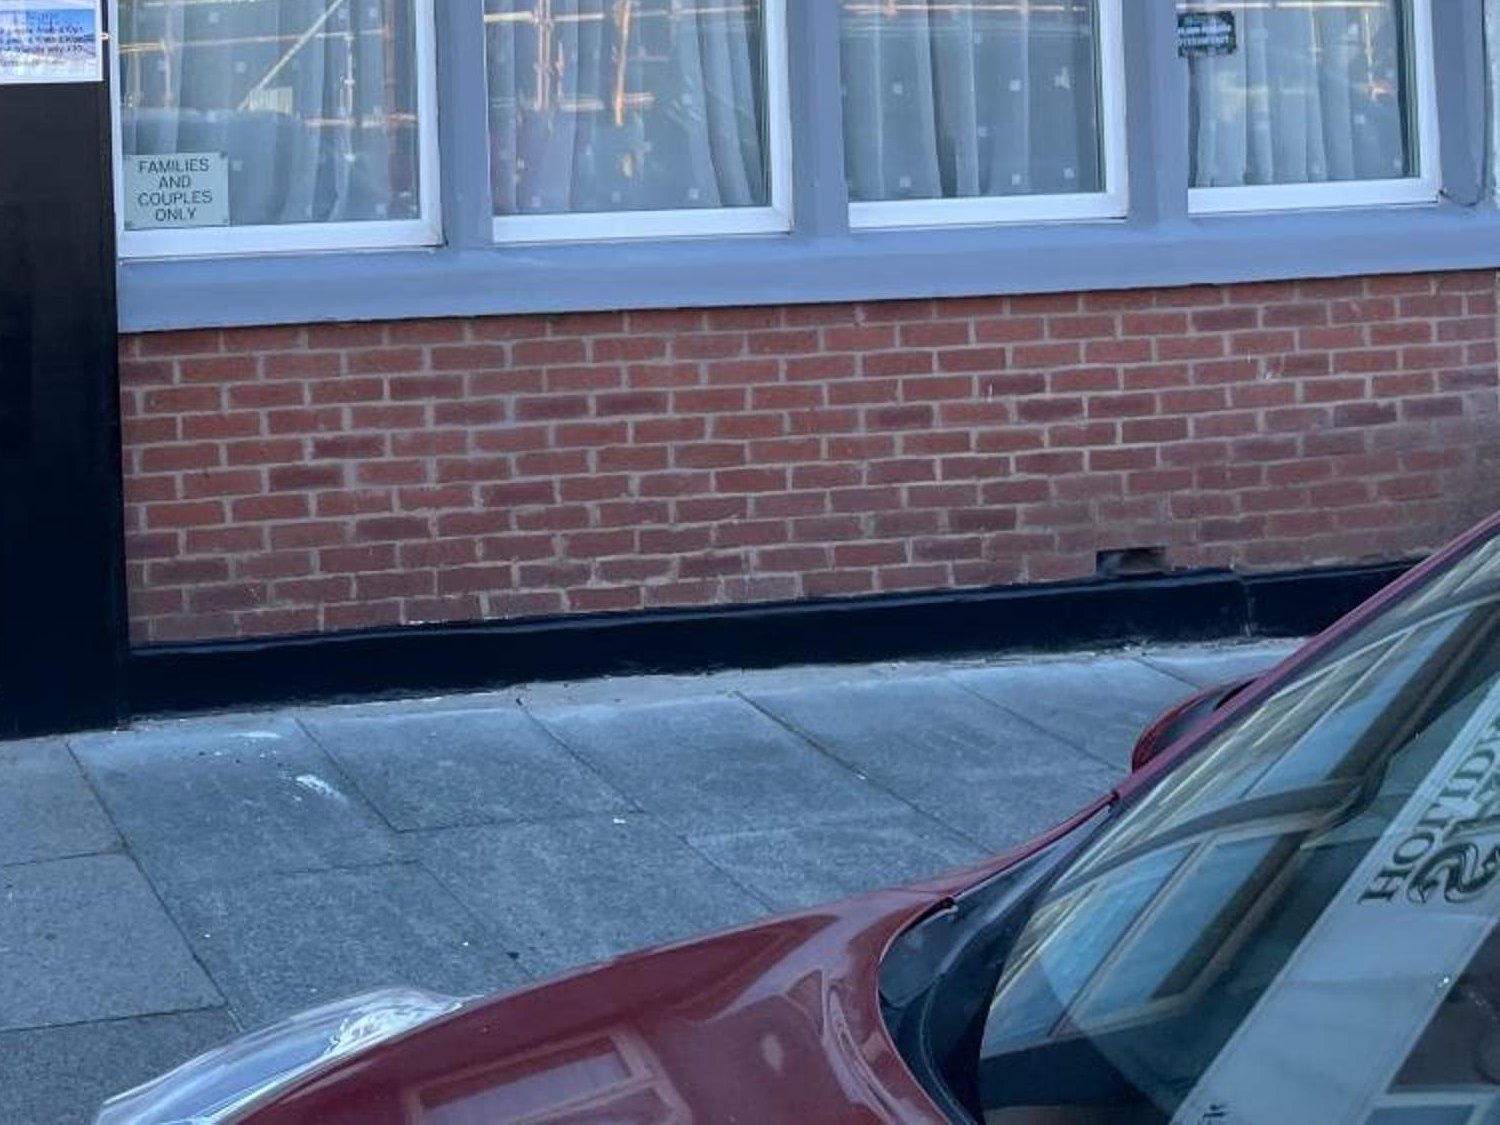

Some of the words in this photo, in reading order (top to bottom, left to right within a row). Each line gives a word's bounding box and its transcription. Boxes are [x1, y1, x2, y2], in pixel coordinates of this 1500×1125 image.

[138, 158, 209, 173] FAMILIES
[159, 175, 191, 188] AND
[138, 190, 213, 206] COUPLES
[155, 207, 197, 222] ONLY
